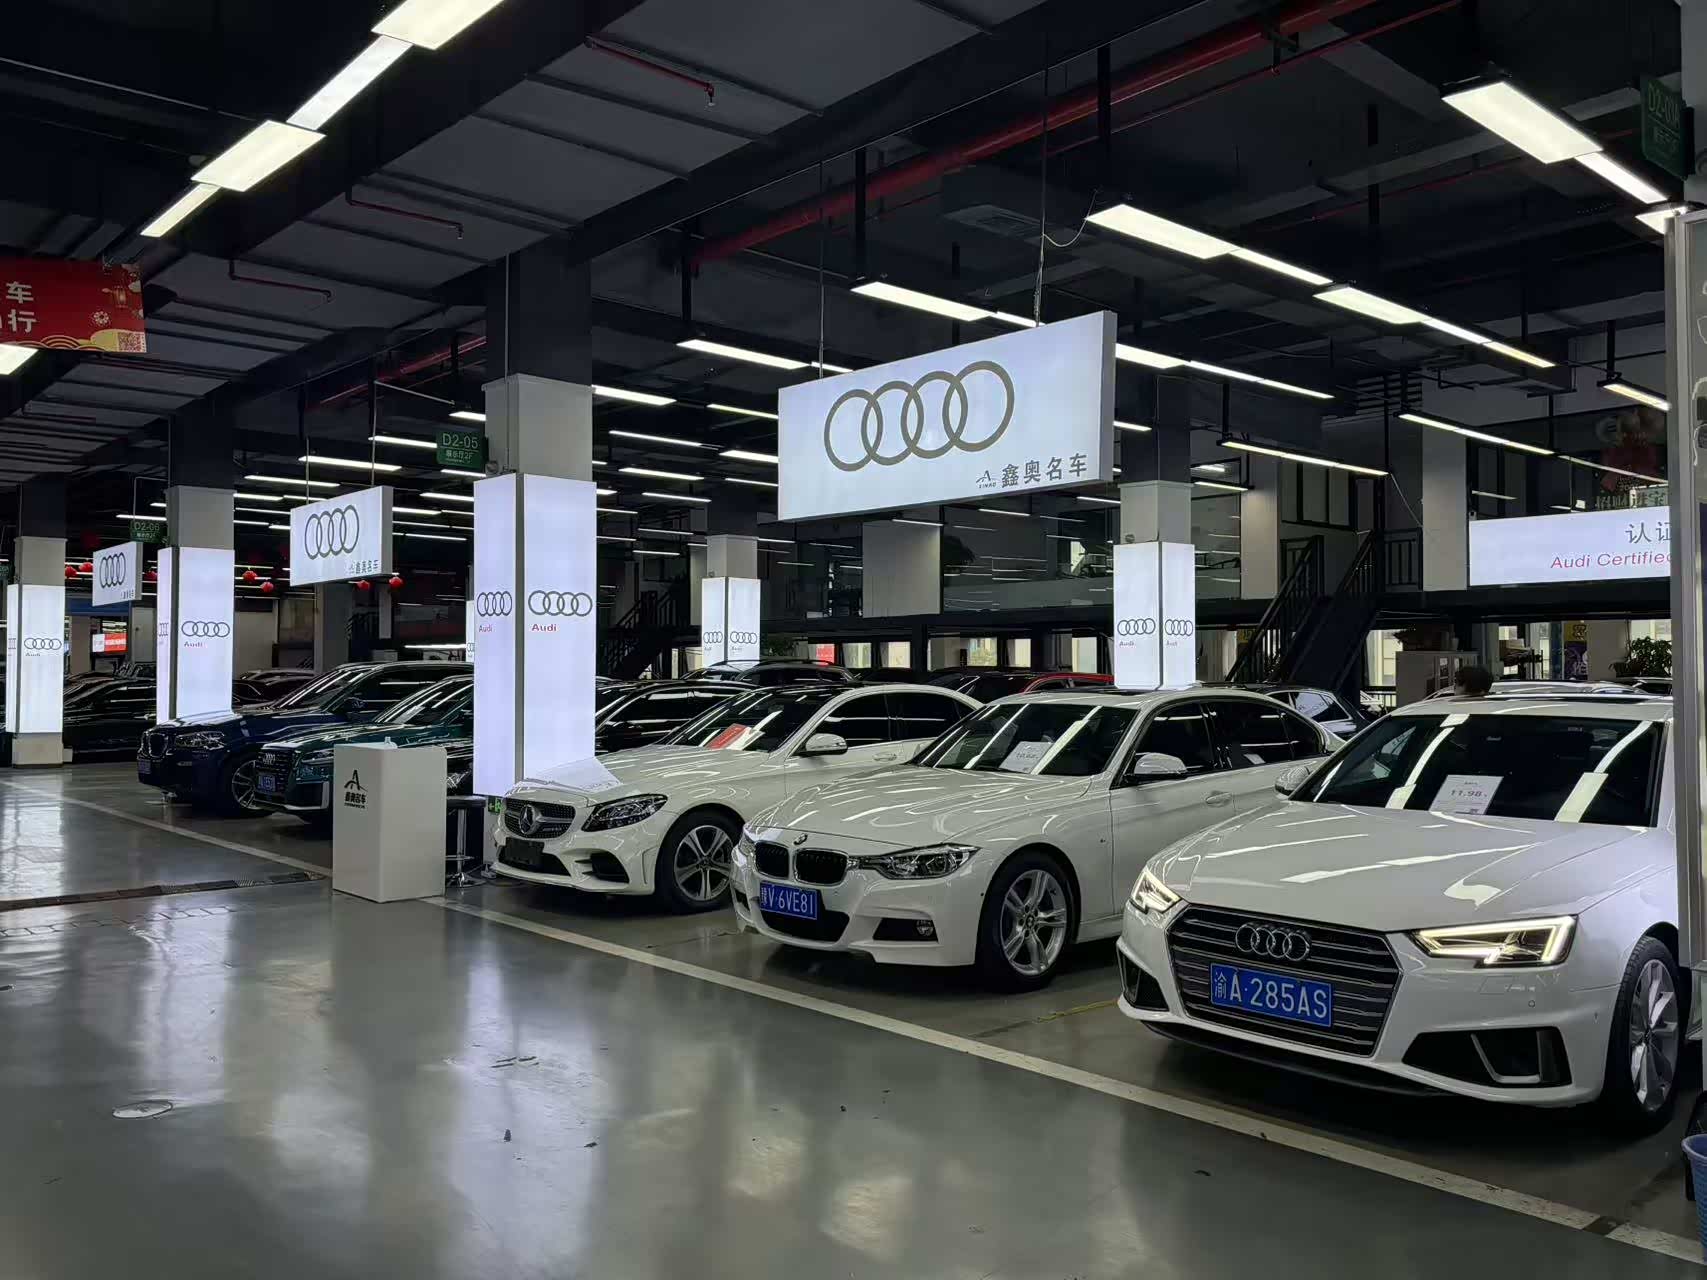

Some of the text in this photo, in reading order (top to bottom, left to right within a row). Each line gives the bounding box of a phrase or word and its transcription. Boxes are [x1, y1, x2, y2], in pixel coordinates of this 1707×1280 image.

[6, 281, 34, 304] 车
[0, 308, 37, 333] 行
[442, 433, 479, 449] D2-05
[1001, 452, 1088, 488] 鑫奥名车
[1550, 554, 1591, 569] Audi
[478, 623, 493, 633] Audi
[531, 623, 557, 632] Audi
